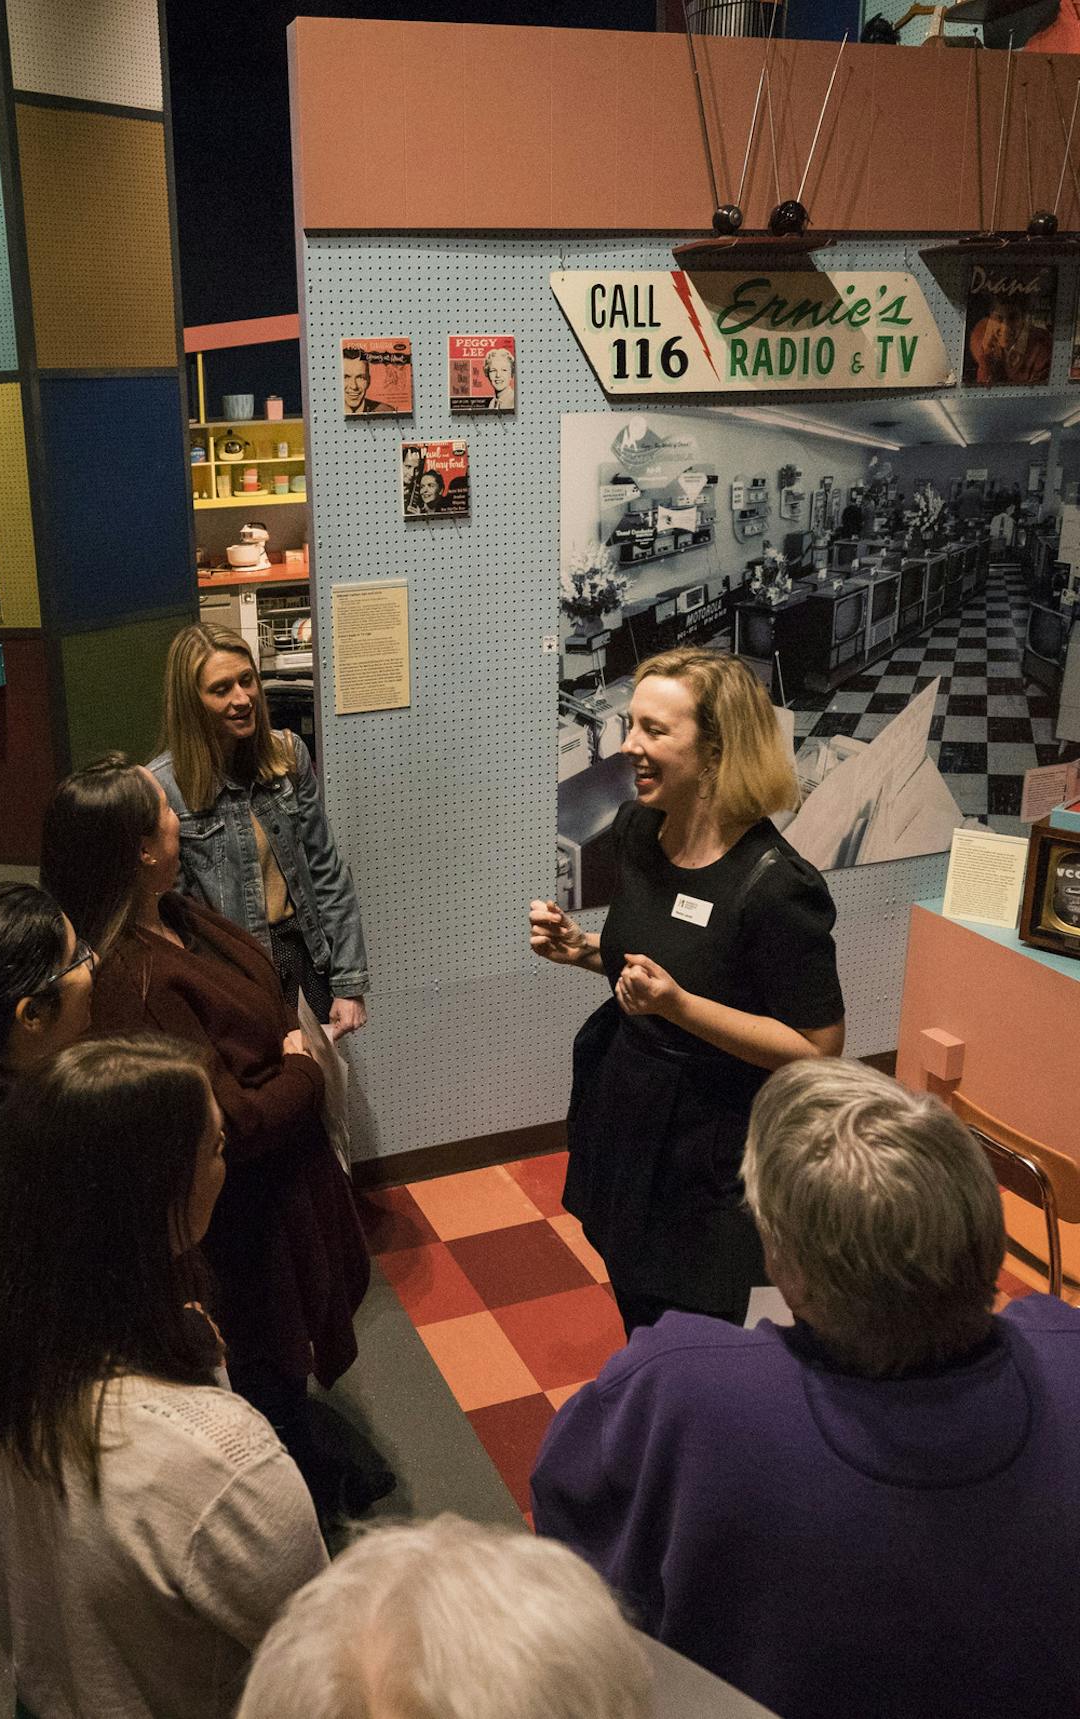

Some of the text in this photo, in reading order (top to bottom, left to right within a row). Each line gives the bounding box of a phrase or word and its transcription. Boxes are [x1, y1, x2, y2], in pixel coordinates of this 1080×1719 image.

[590, 282, 662, 330] CALL
[718, 277, 913, 336] Ernie's
[455, 338, 497, 348] PEGGY
[462, 348, 485, 357] LEE
[611, 335, 689, 380] 116
[729, 334, 920, 378] RADIO & TV
[426, 460, 448, 472] Mary
